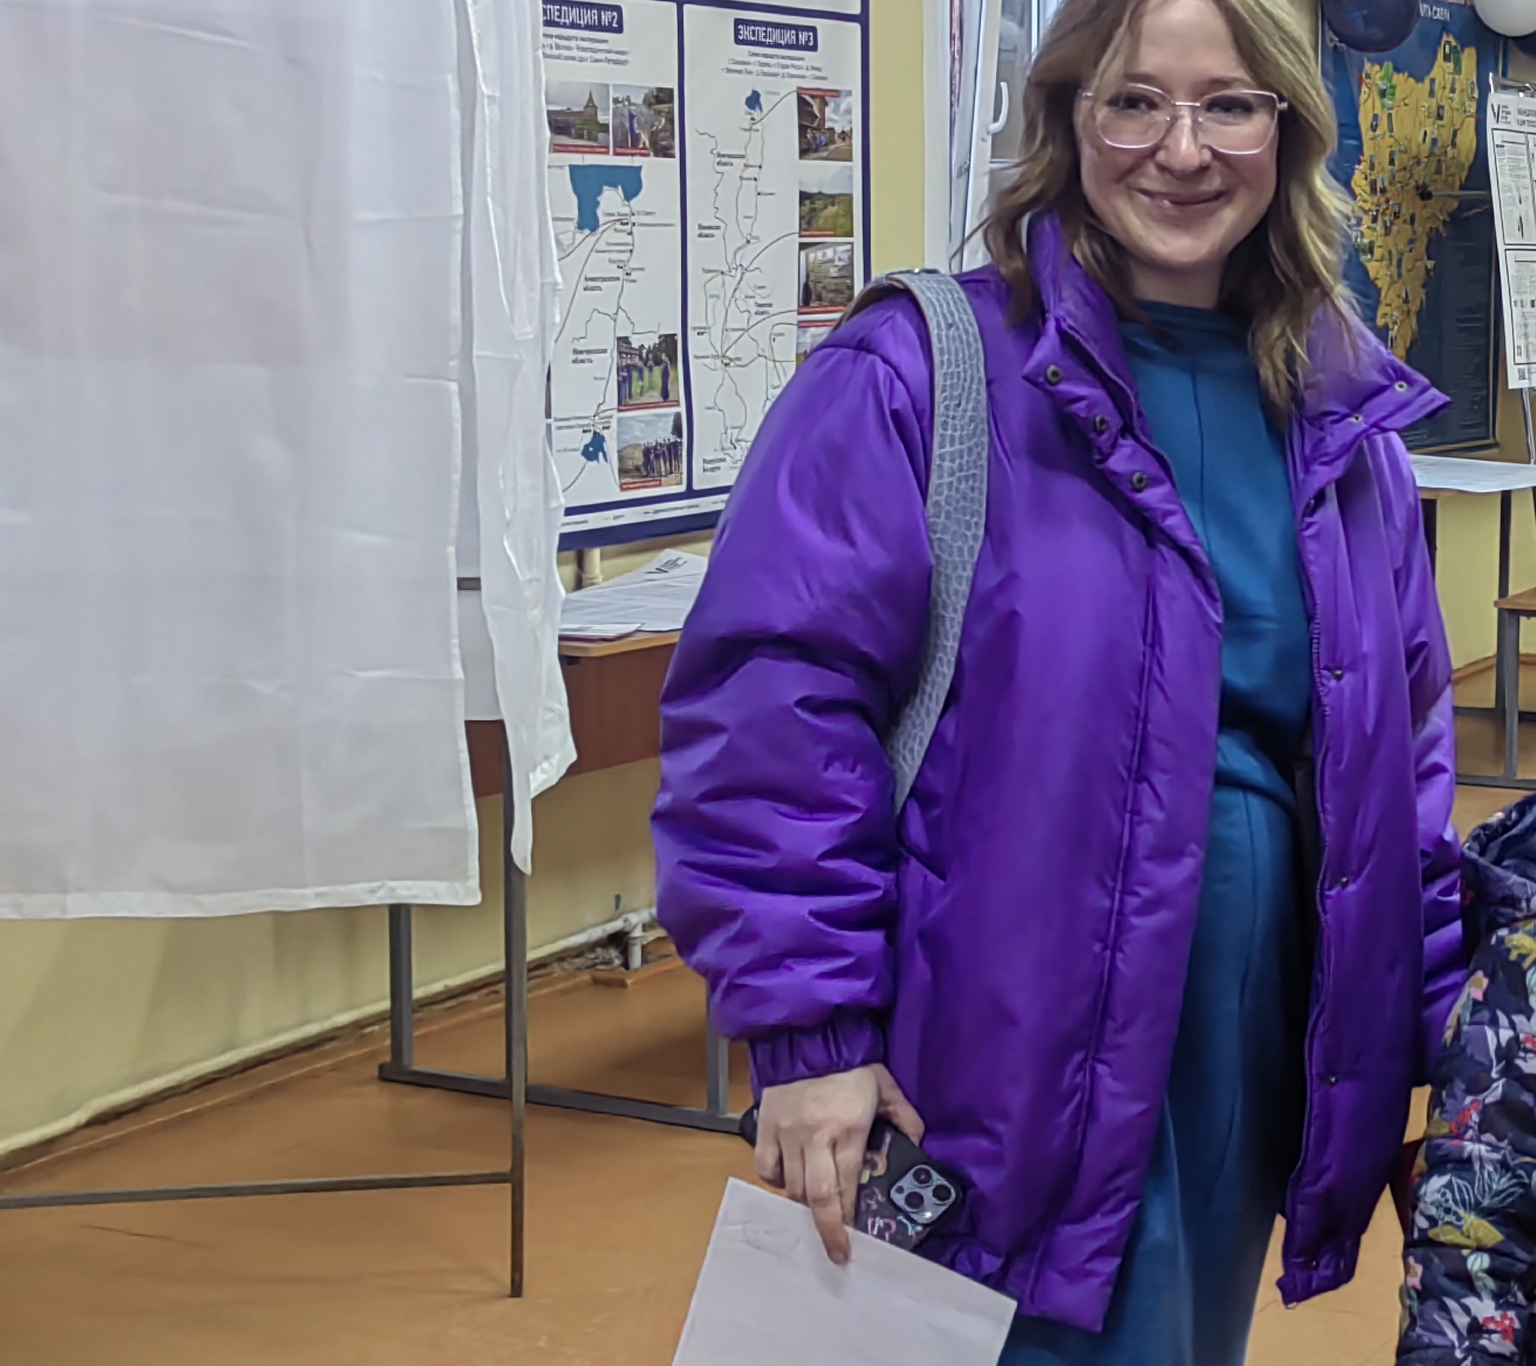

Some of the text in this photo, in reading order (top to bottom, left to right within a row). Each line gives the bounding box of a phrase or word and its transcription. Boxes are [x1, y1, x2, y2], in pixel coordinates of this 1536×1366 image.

[601, 9, 619, 28] №2
[737, 24, 814, 47] ЭКСПЕДИЦИЯ №3
